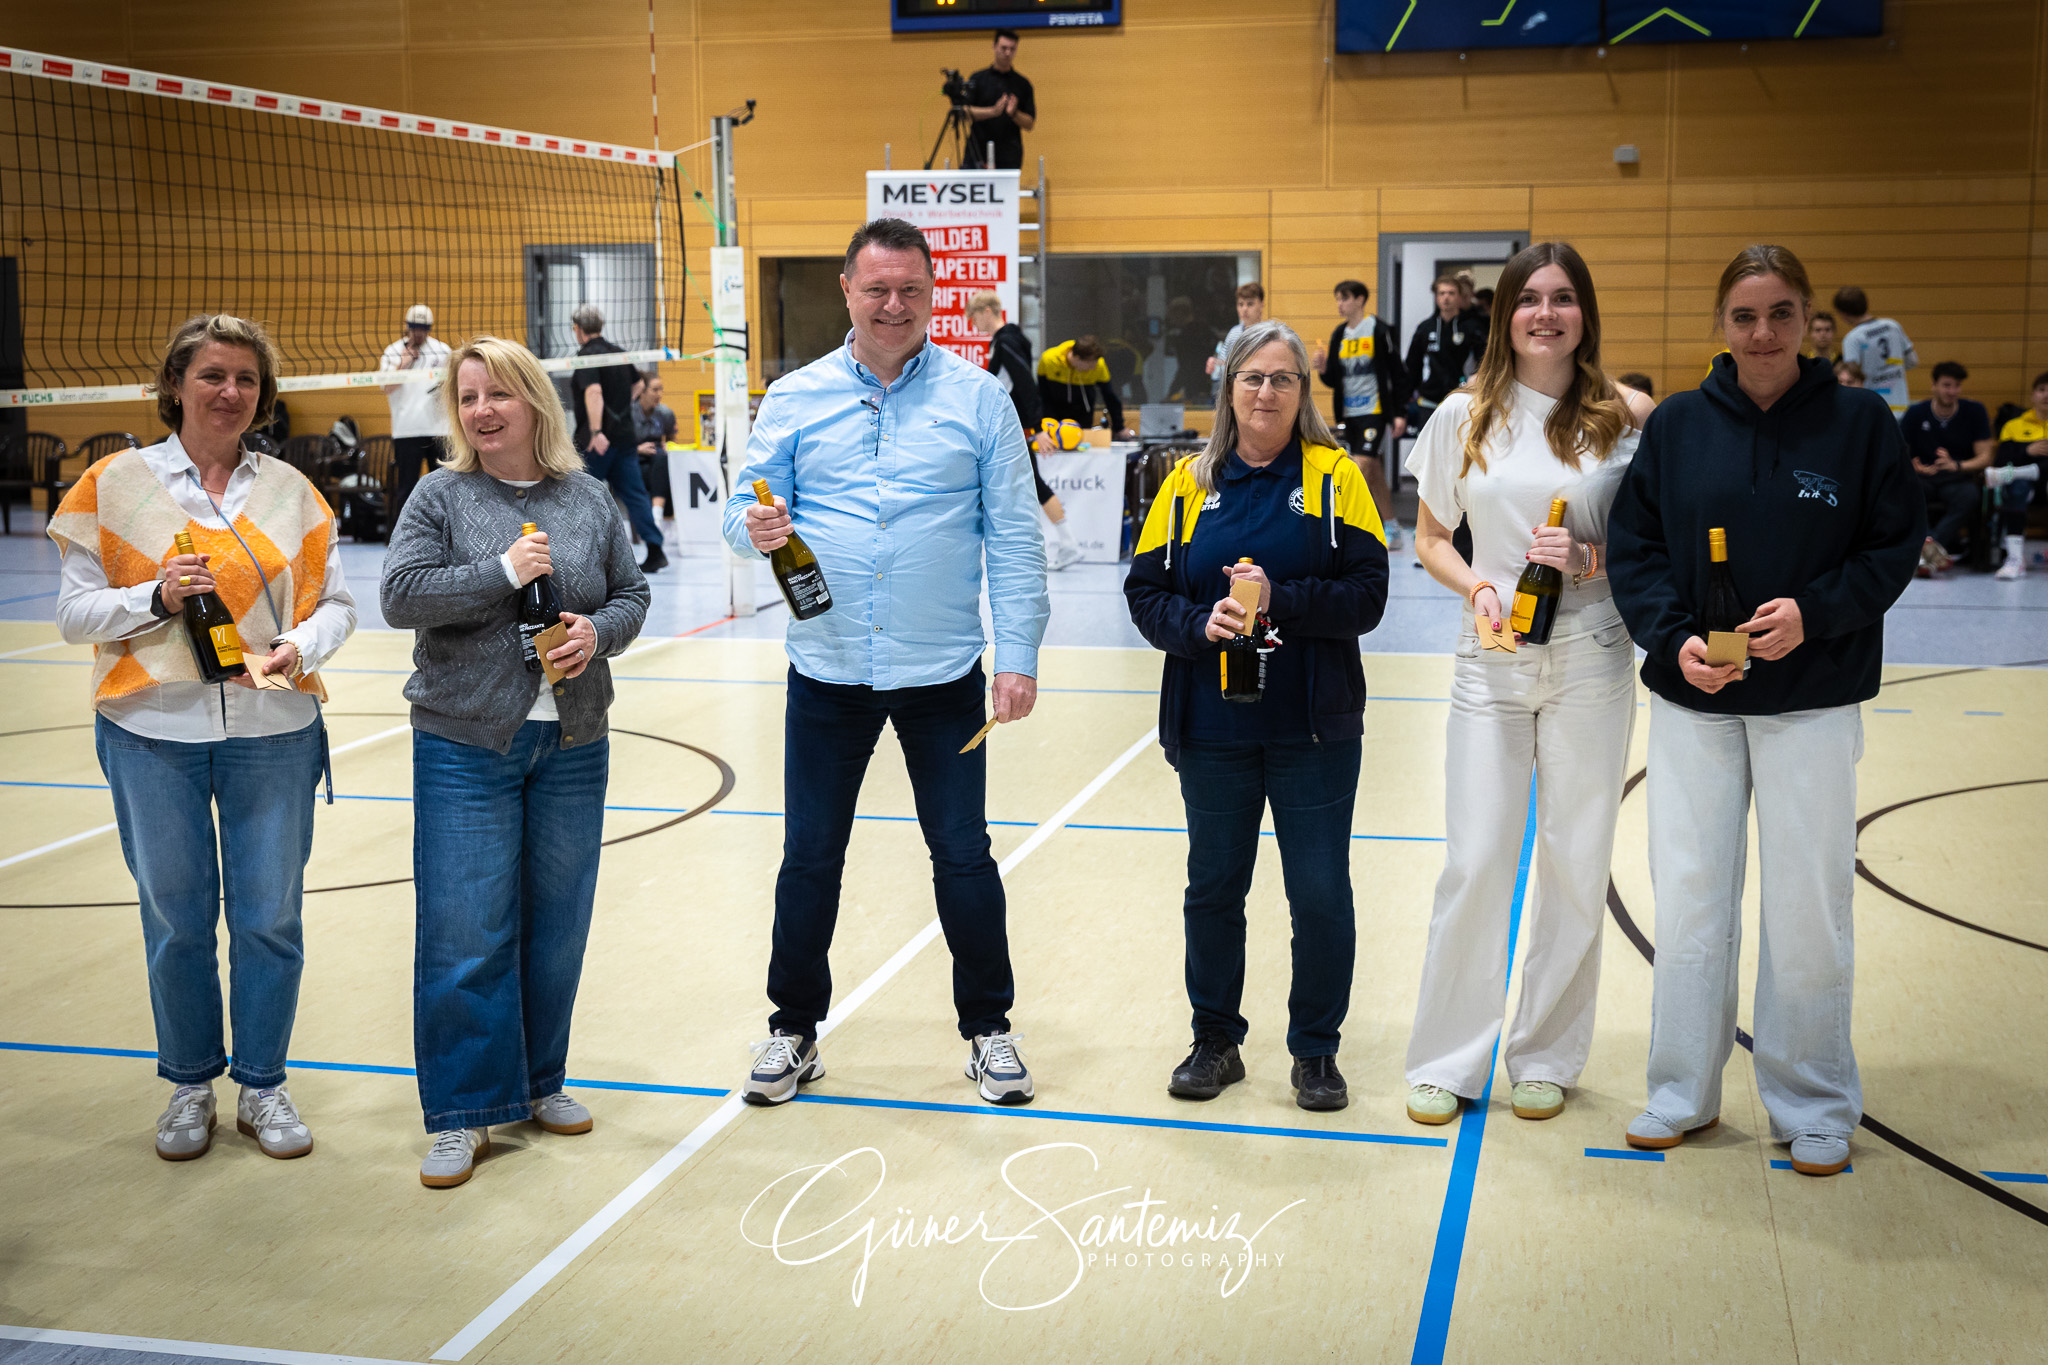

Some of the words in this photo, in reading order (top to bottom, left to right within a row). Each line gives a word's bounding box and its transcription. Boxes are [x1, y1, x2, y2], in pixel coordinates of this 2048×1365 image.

[1048, 12, 1104, 26] PEWETA
[882, 183, 1004, 204] MEYSEL
[923, 227, 983, 252] HILDER
[1877, 337, 1890, 360] 3
[21, 392, 54, 404] FUCHS
